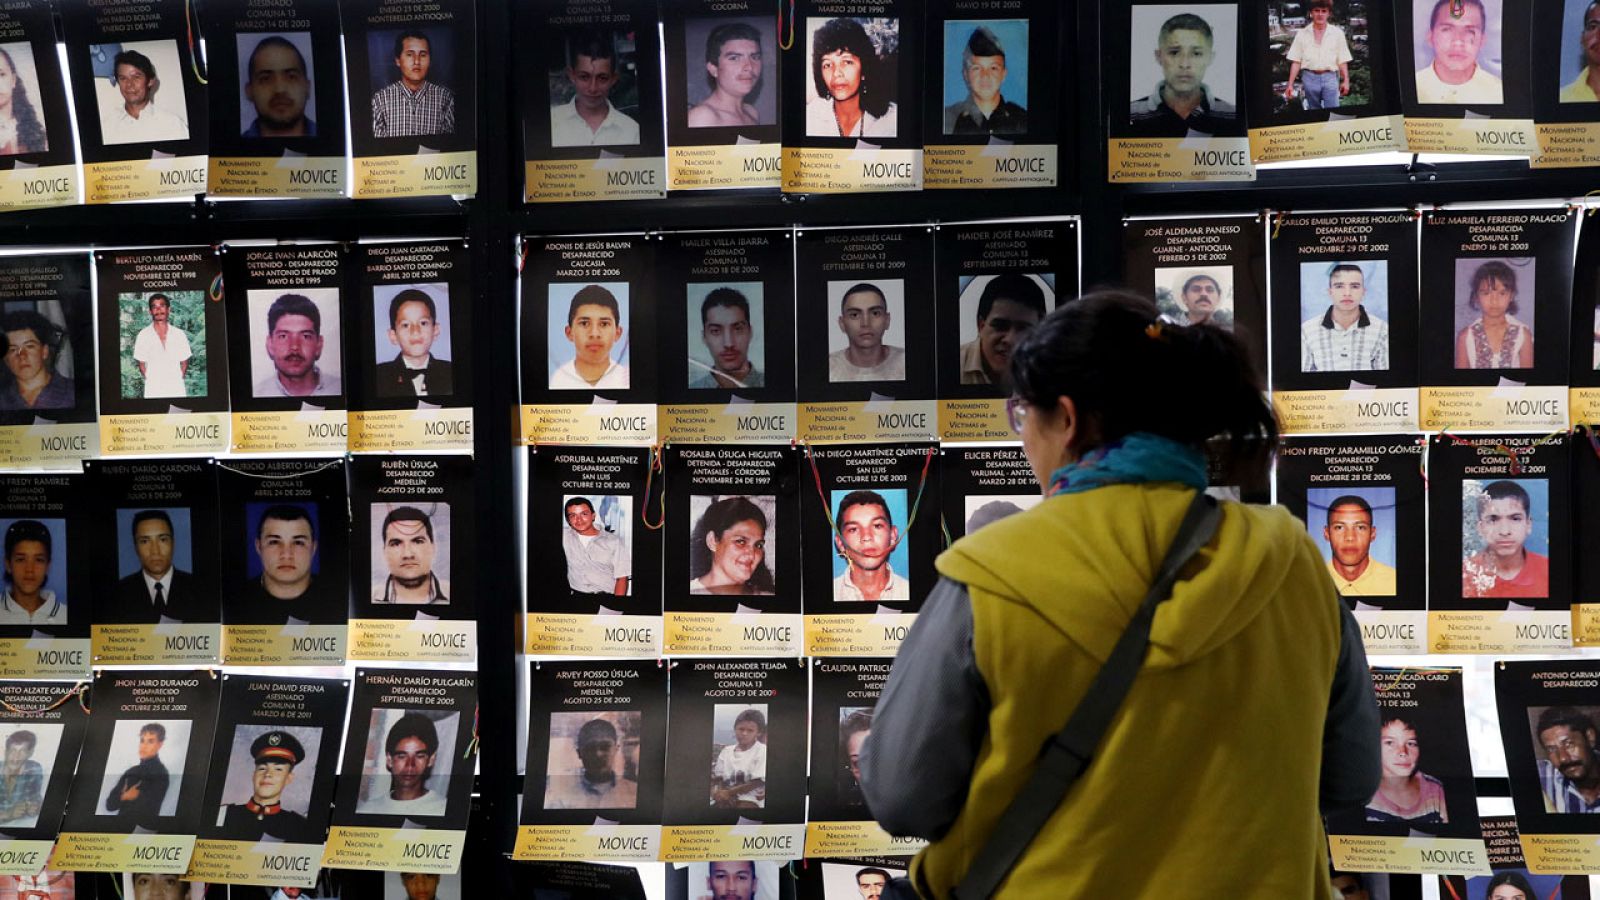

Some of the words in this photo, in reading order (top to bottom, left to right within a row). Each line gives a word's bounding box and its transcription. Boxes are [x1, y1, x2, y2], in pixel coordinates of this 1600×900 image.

[1340, 128, 1393, 145] MOVICE
[1476, 131, 1526, 145] MOVICE
[1195, 151, 1245, 166] MOVICE
[743, 157, 781, 172] MOVIC
[995, 158, 1045, 173] MOVICE
[290, 169, 337, 184] MOVICE
[424, 164, 467, 180] MOVICE
[863, 163, 912, 179] MOVICE
[160, 168, 206, 186] MOVICE
[607, 170, 655, 186] MOVICE
[24, 178, 69, 195] MOVICE
[1311, 217, 1338, 225] EMILIO
[1340, 216, 1368, 224] TORRES
[1448, 216, 1485, 225] MARIELA
[1487, 215, 1528, 223] FERREIRO
[1530, 214, 1566, 223] PALACIO
[1144, 226, 1163, 236] JOSÉ
[1165, 227, 1204, 235] ALDEMAR
[1205, 225, 1241, 234] PANESSO
[1316, 226, 1372, 235] DESAPARECIDO
[1469, 225, 1523, 234] DESAPARECIDA
[1167, 236, 1220, 244] DESAPARECIDO
[368, 248, 389, 256] DIEGO
[390, 247, 408, 256] JUAN
[410, 245, 450, 254] CARTAGENA
[545, 242, 573, 251] ADONIS
[575, 242, 584, 250] DE
[605, 241, 631, 250] BALVIN
[116, 255, 151, 265] BERTULFO
[247, 252, 273, 261] JORGE
[275, 252, 295, 260] IVAN
[297, 249, 338, 259] ALARCÓN
[385, 255, 433, 263] DESAPARECIDO
[562, 251, 614, 259] DESAPARECIDO
[136, 264, 184, 272] DESAPARECIDO
[288, 259, 339, 268] DESAPARECIDO
[571, 260, 605, 268] CAUCASIA
[143, 280, 178, 289] COCORNÁ
[1358, 401, 1409, 418] MOVICE
[1506, 399, 1559, 415] MOVICE
[600, 416, 647, 431] MOVICE
[736, 416, 785, 431] MOVICE
[878, 413, 926, 429] MOVICE
[175, 424, 219, 440] MOVICE
[308, 423, 347, 438] MOVIC
[424, 420, 470, 436] MOVICE
[41, 435, 87, 451] MOVICE
[1504, 438, 1529, 446] TIQUE
[680, 450, 717, 459] ROSALBA
[749, 451, 783, 459] HIGUITA
[827, 450, 852, 458] DIEGO
[854, 448, 894, 457] MARTÍNEZ
[1308, 446, 1335, 455] FREDY
[1337, 445, 1385, 454] JARAMILLO
[382, 460, 408, 469] RUBÉN
[554, 455, 595, 464] ASDRUBAL
[596, 454, 639, 464] MARTÍNEZ
[846, 458, 897, 466] DESAPARECIDO
[1324, 456, 1378, 464] DESAPARECIDO
[386, 470, 435, 478] DESAPARECIDO
[836, 475, 869, 483] OCTUBRE
[605, 628, 651, 643] MOVICE
[743, 626, 791, 643] MOVICE
[1363, 624, 1414, 640] MOVICE
[1515, 624, 1568, 640] MOVICE
[165, 636, 209, 651] MOVICE
[292, 637, 336, 652] MOVICE
[420, 633, 466, 649] MOVICE
[37, 650, 82, 665] MOVICE
[717, 663, 758, 671] ALEXANDER
[760, 662, 787, 670] TEJADA
[556, 671, 582, 679] ARVEY
[583, 671, 609, 679] POSSO
[714, 672, 767, 680] DESAPARECIDO
[1531, 671, 1567, 680] ANTONIO
[138, 679, 158, 687] JAIRO
[160, 679, 200, 687] DURANGO
[248, 683, 270, 691] JUAN
[272, 684, 296, 692] DAVID
[297, 684, 325, 693] SERNA
[1543, 680, 1598, 689] DESAPARECIDO
[132, 688, 179, 696] DESAPARECIDO
[391, 686, 446, 695] DESAPARECIDO
[704, 689, 735, 697] AGOSTO
[747, 689, 757, 697] DE
[598, 836, 648, 851] MOVICE
[742, 835, 792, 850] MOVICE
[133, 846, 182, 861] MOVICE
[402, 843, 452, 860] MOVICE
[1421, 849, 1475, 865] MOVICE
[262, 855, 310, 871] MOVICE
